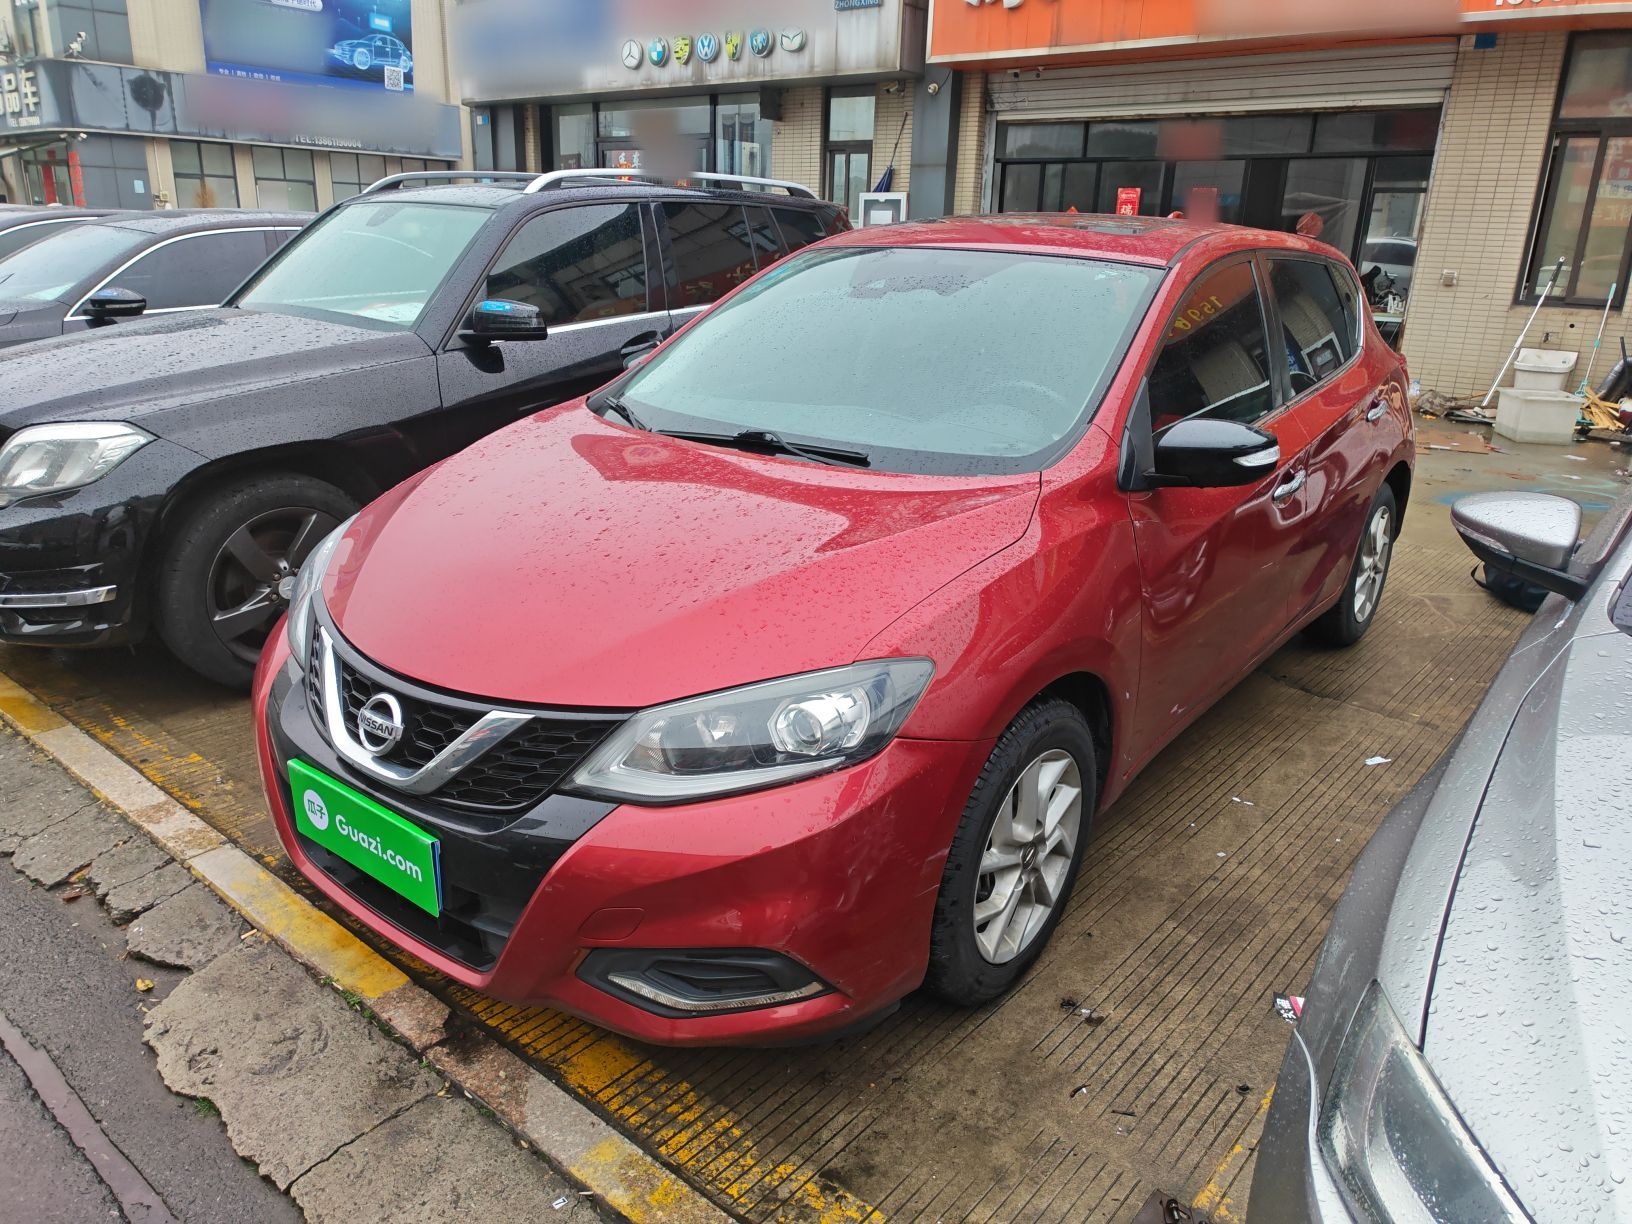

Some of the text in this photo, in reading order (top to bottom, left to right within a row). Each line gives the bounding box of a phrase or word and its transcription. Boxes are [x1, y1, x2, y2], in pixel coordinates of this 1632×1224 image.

[359, 714, 394, 737] NISSAN
[307, 799, 326, 821] 瓜子
[335, 814, 423, 882] Guazi.com
